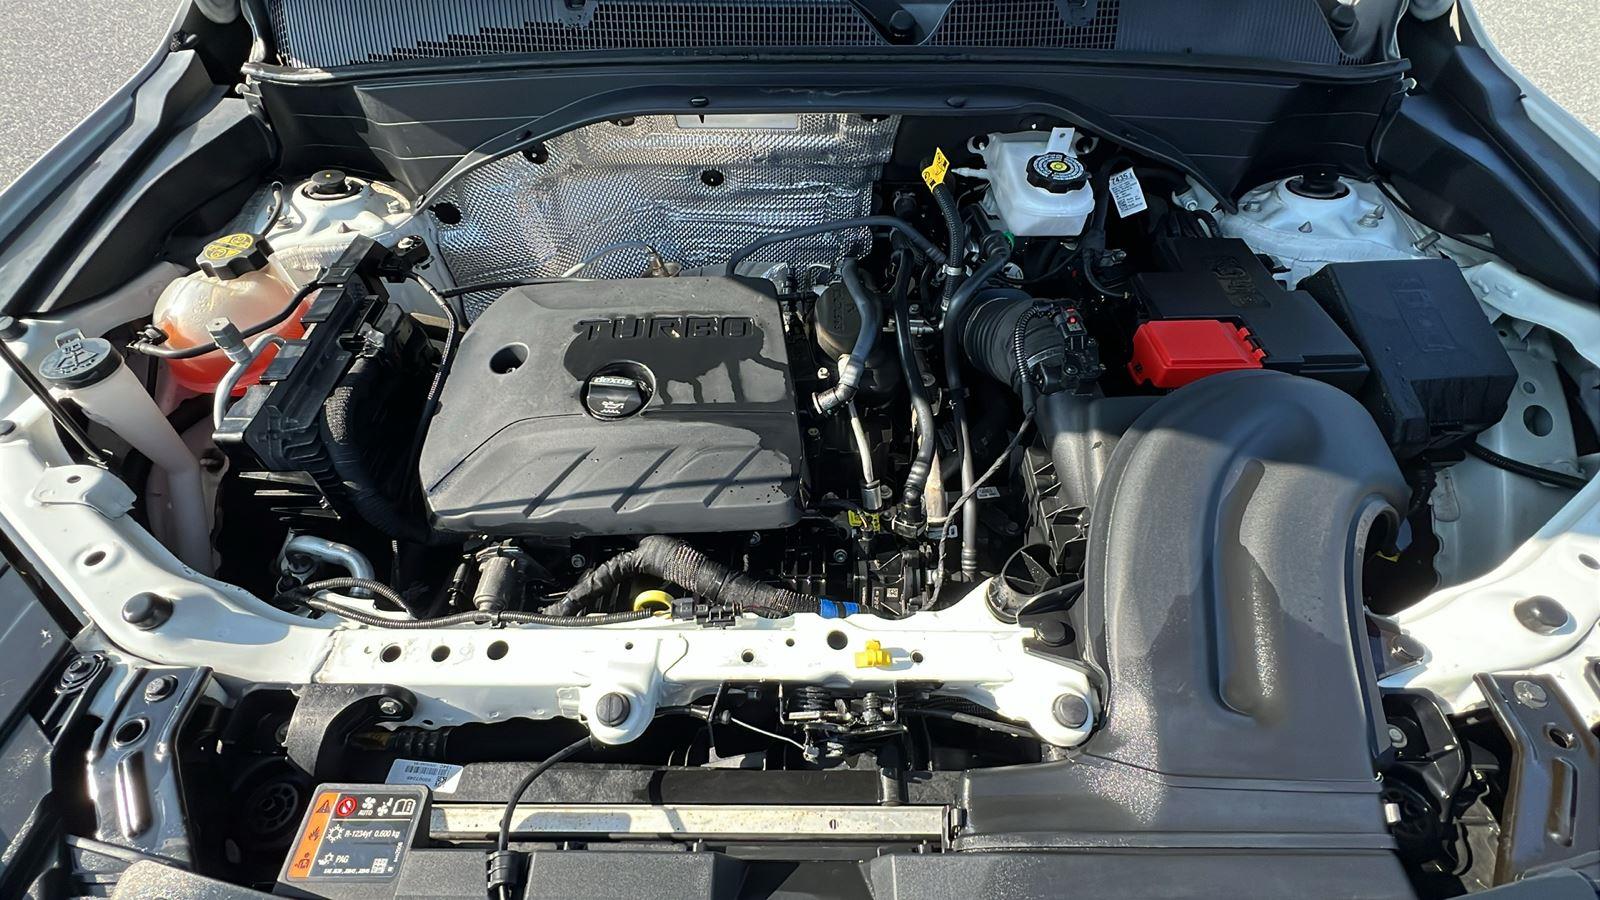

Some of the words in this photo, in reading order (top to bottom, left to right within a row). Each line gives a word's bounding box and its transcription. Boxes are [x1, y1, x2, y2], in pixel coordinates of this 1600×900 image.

[579, 315, 754, 340] TURBO
[594, 376, 636, 386] dexos
[304, 717, 318, 727] RH
[344, 829, 372, 839] R-1234yf
[391, 830, 401, 839] kg
[335, 855, 350, 864] PAG
